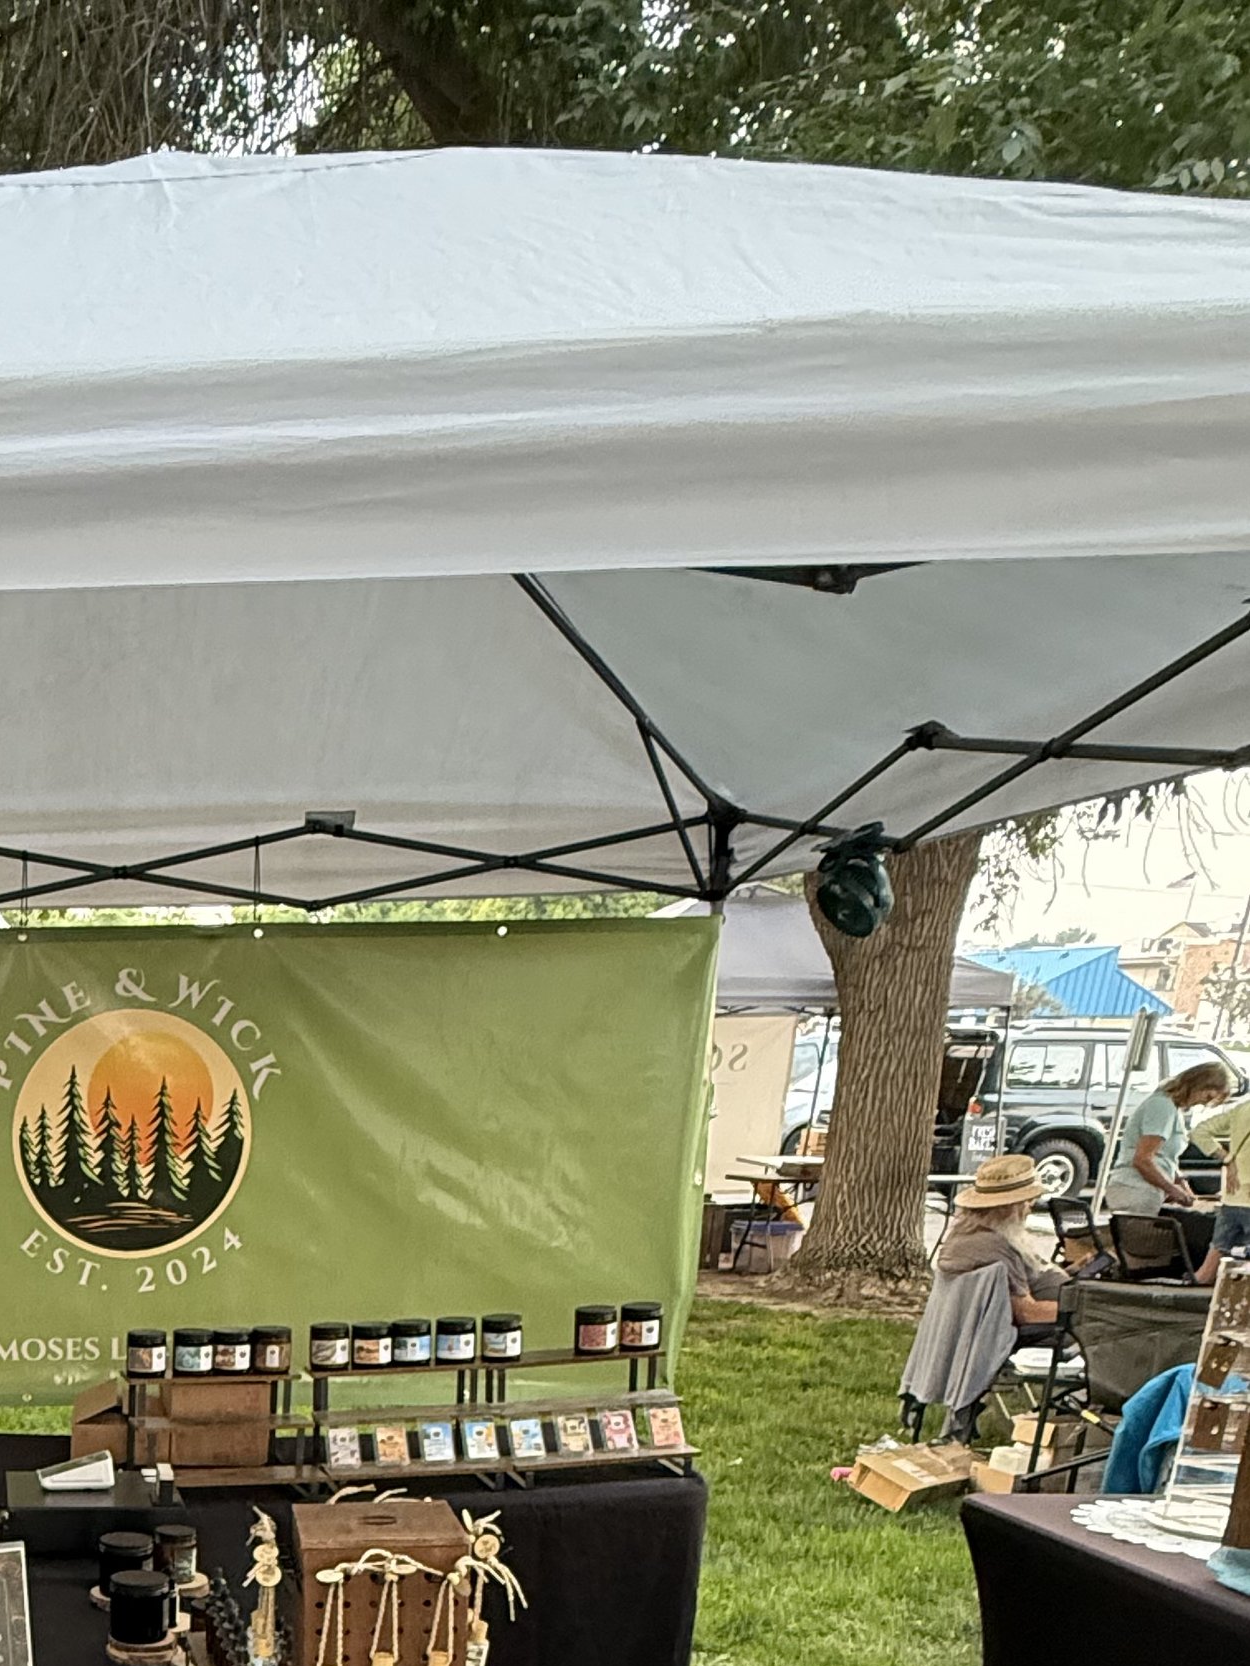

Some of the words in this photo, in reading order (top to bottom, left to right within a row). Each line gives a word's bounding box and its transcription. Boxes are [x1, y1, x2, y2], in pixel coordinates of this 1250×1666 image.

[114, 967, 158, 1002] &
[168, 973, 282, 1100] WICK
[19, 1228, 108, 1291] EST.
[135, 1227, 243, 1293] 2024
